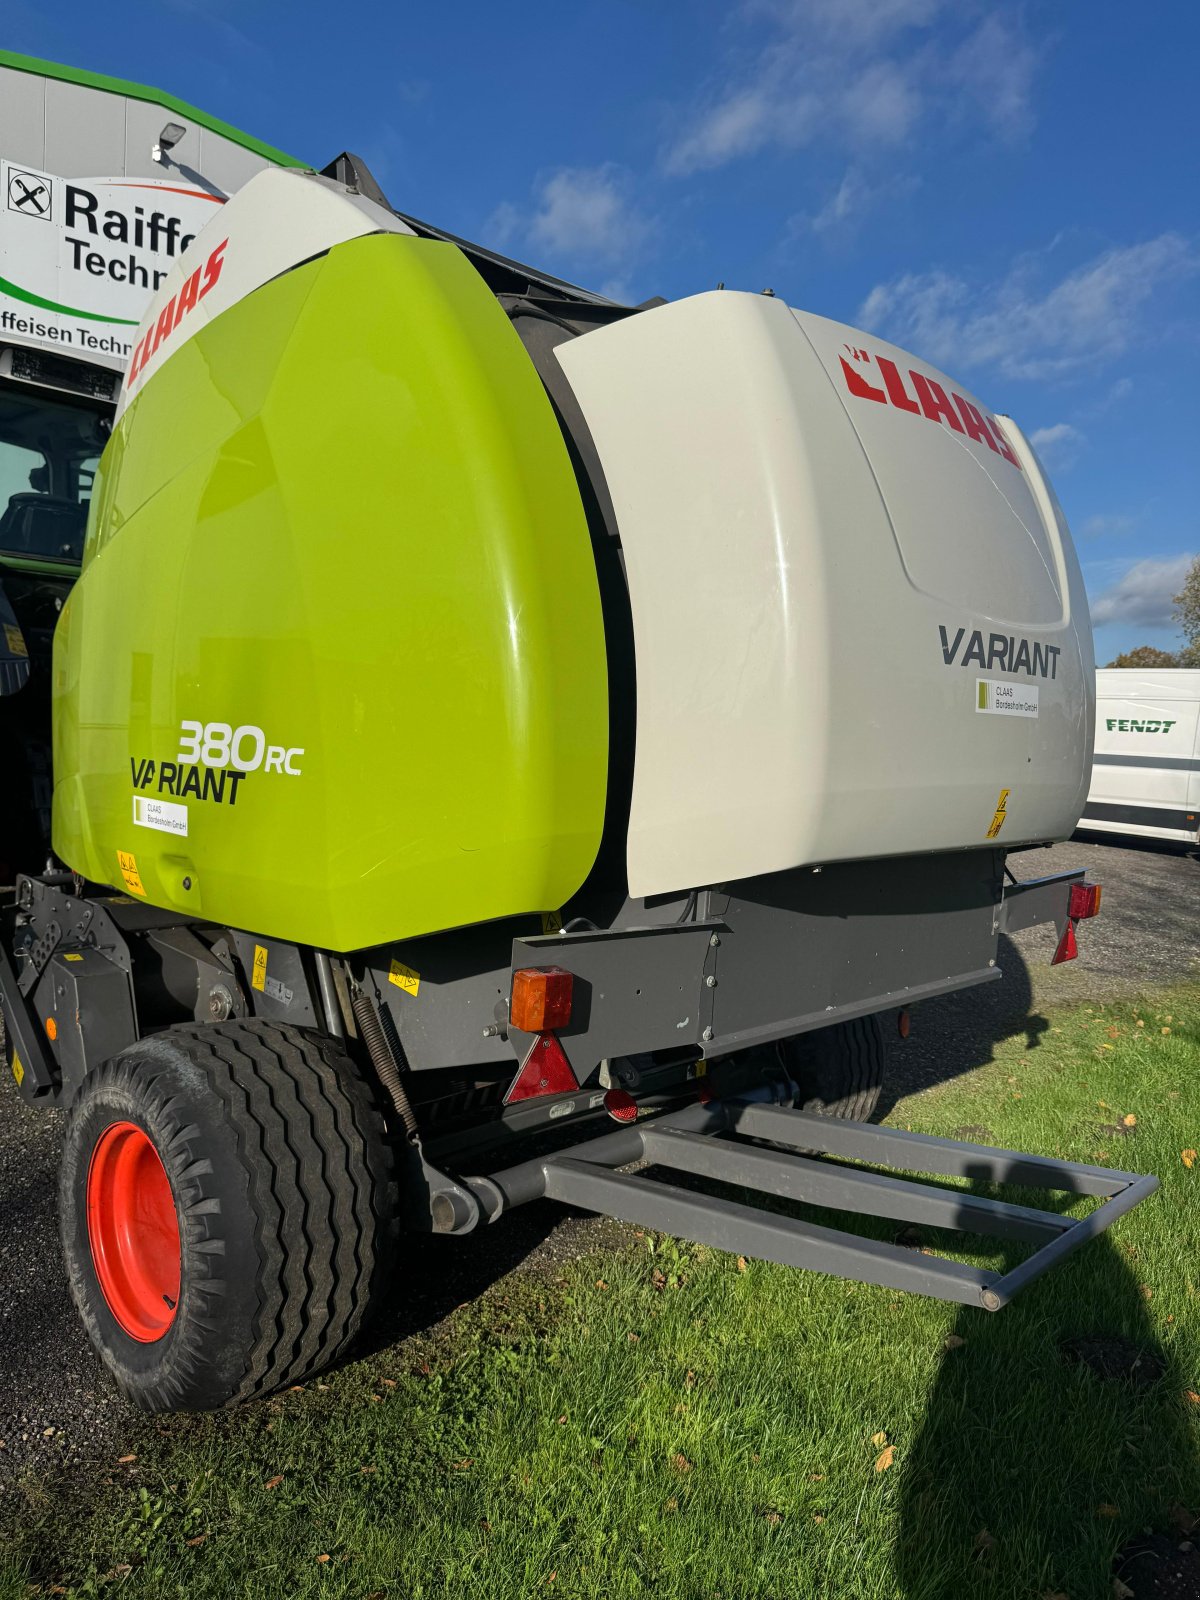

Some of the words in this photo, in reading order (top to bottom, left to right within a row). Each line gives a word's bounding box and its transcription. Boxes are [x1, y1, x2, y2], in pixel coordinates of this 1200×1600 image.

[127, 237, 229, 390] CLAAS
[838, 344, 1022, 471] CLAAS
[938, 625, 1061, 680] VARIANT
[995, 686, 1013, 697] CLAAS
[995, 699, 1024, 712] Bordesholm
[1024, 702, 1038, 713] GmbH
[1106, 719, 1176, 733] FENDT
[130, 757, 246, 805] VARIANT
[147, 803, 162, 814] CLAAS
[172, 819, 187, 831] GmbH
